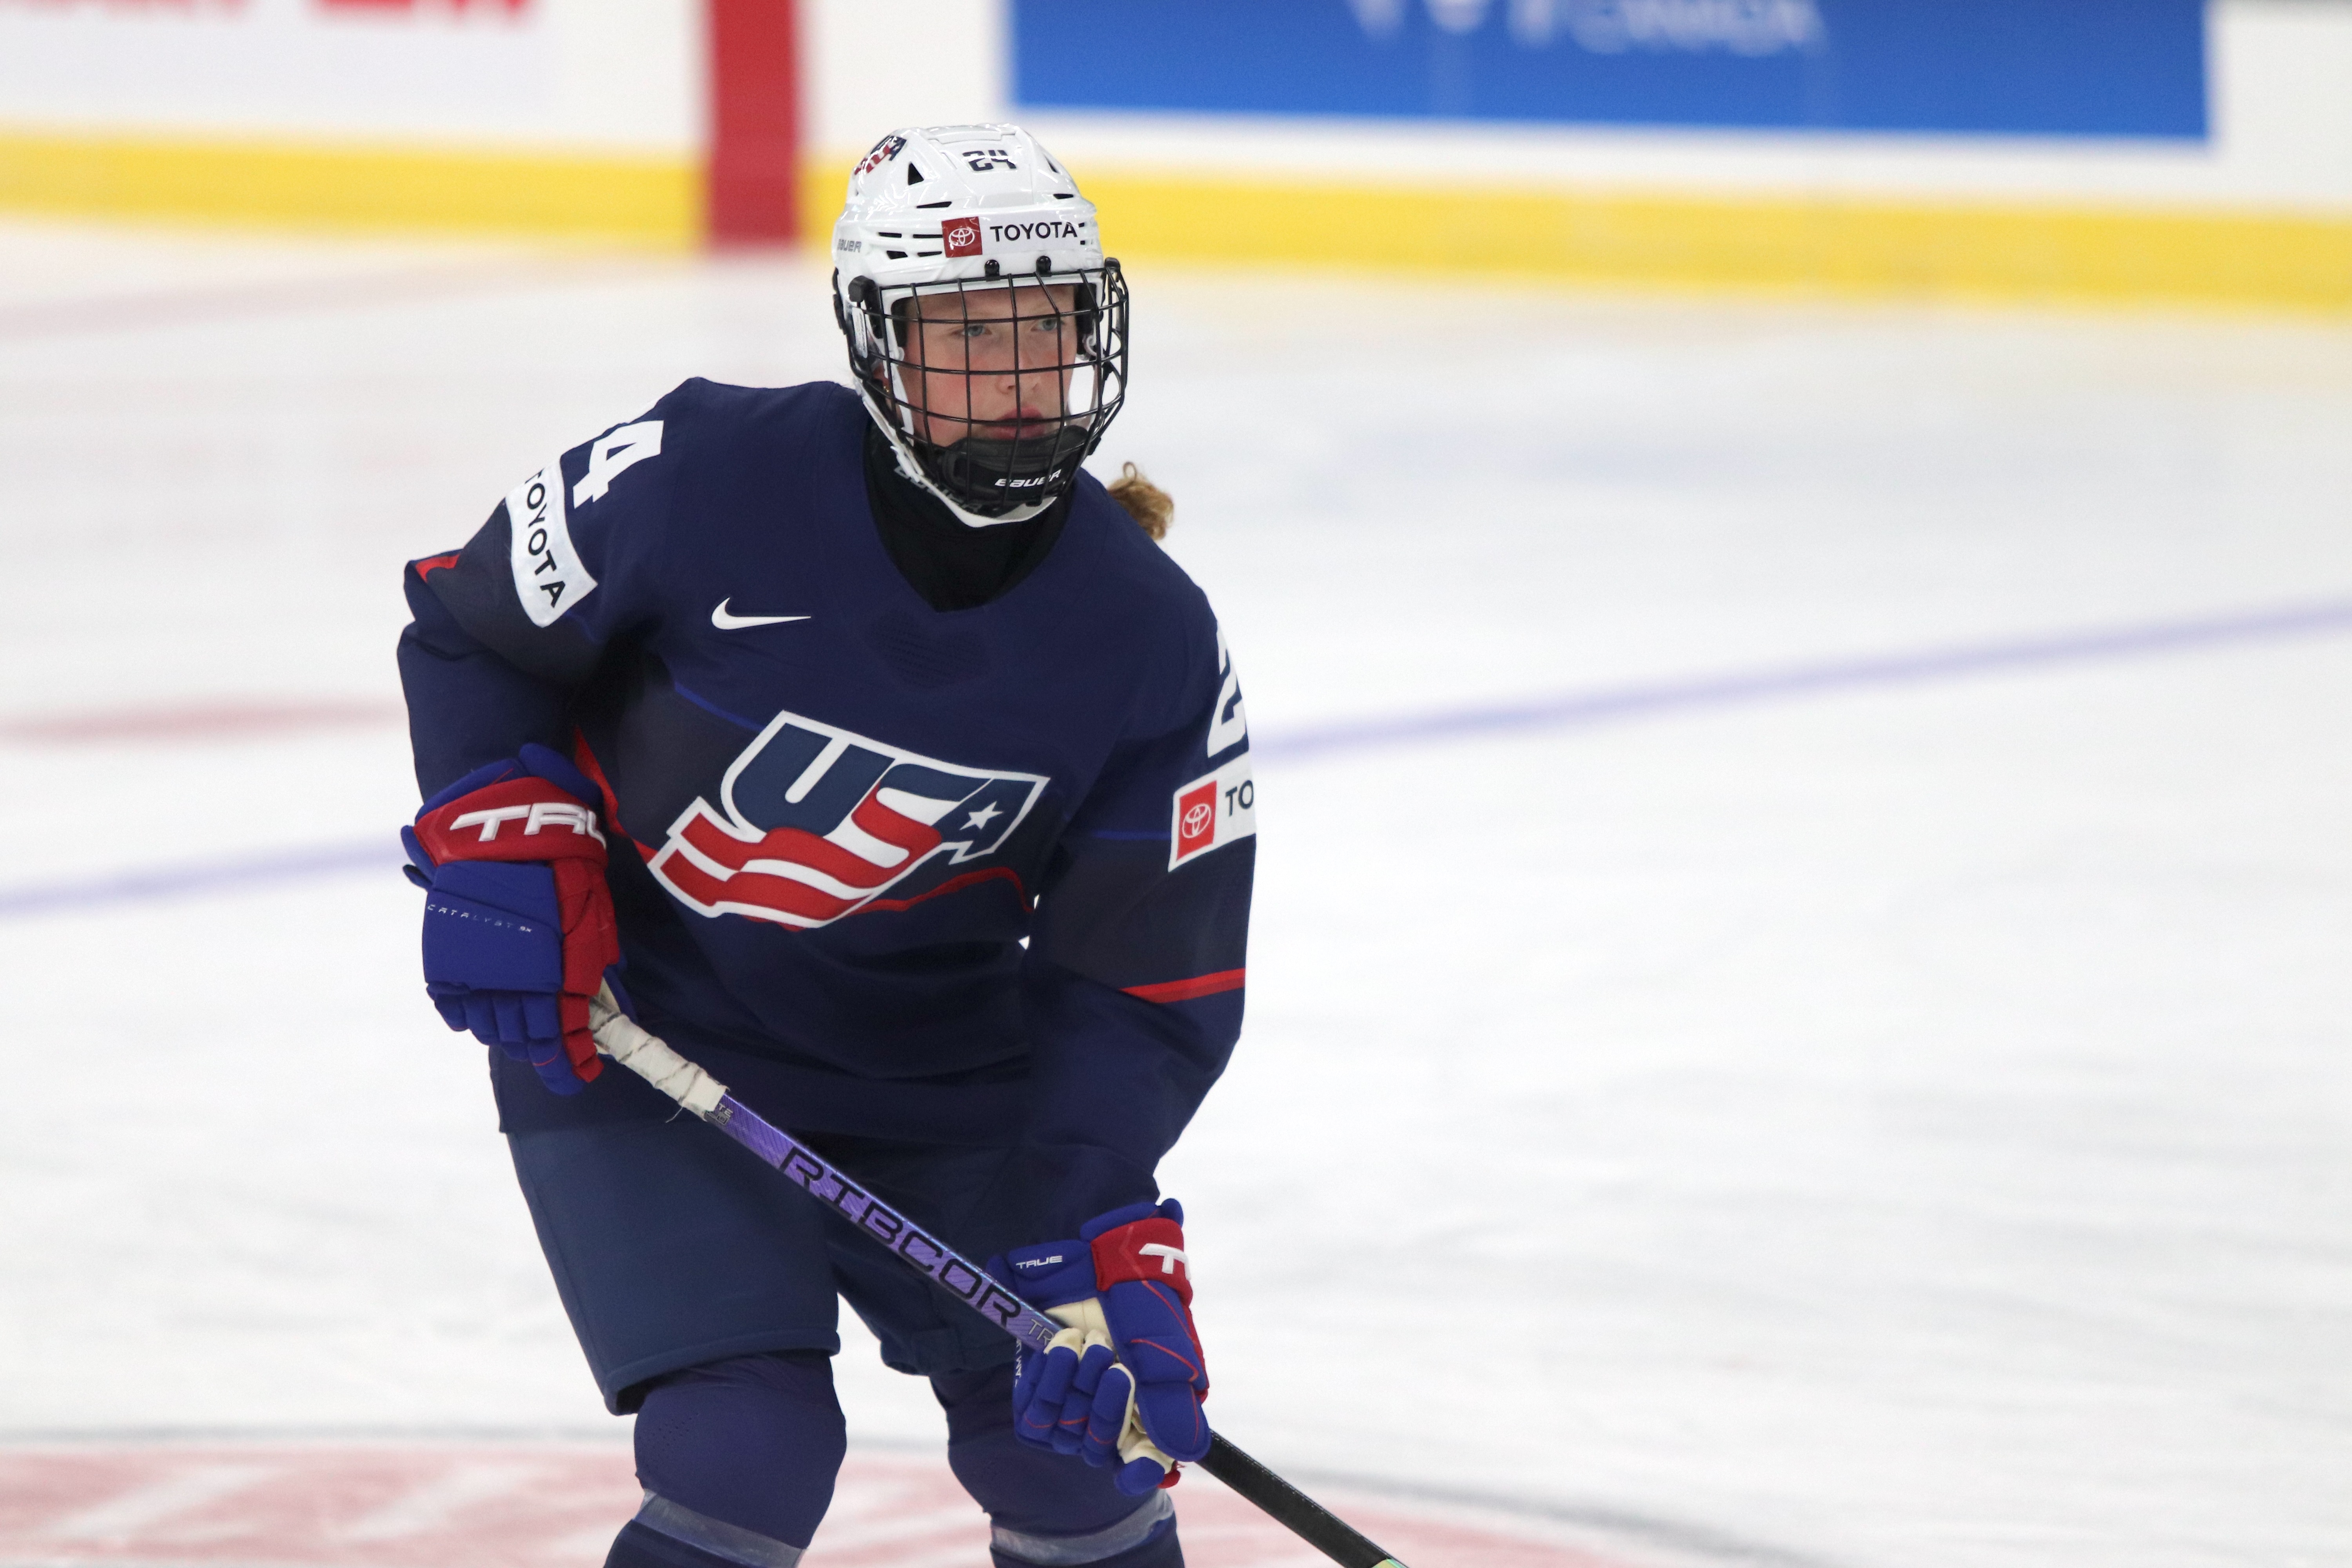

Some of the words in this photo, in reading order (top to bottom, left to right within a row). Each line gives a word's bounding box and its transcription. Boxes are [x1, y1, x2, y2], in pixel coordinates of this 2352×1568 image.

[962, 149, 1017, 171] 24
[990, 222, 1078, 242] TOYOTA
[995, 469, 1062, 488] BAUER
[647, 710, 1051, 929] USA
[779, 1146, 1021, 1328] RIBCOR
[1016, 1255, 1063, 1269] TRUE
